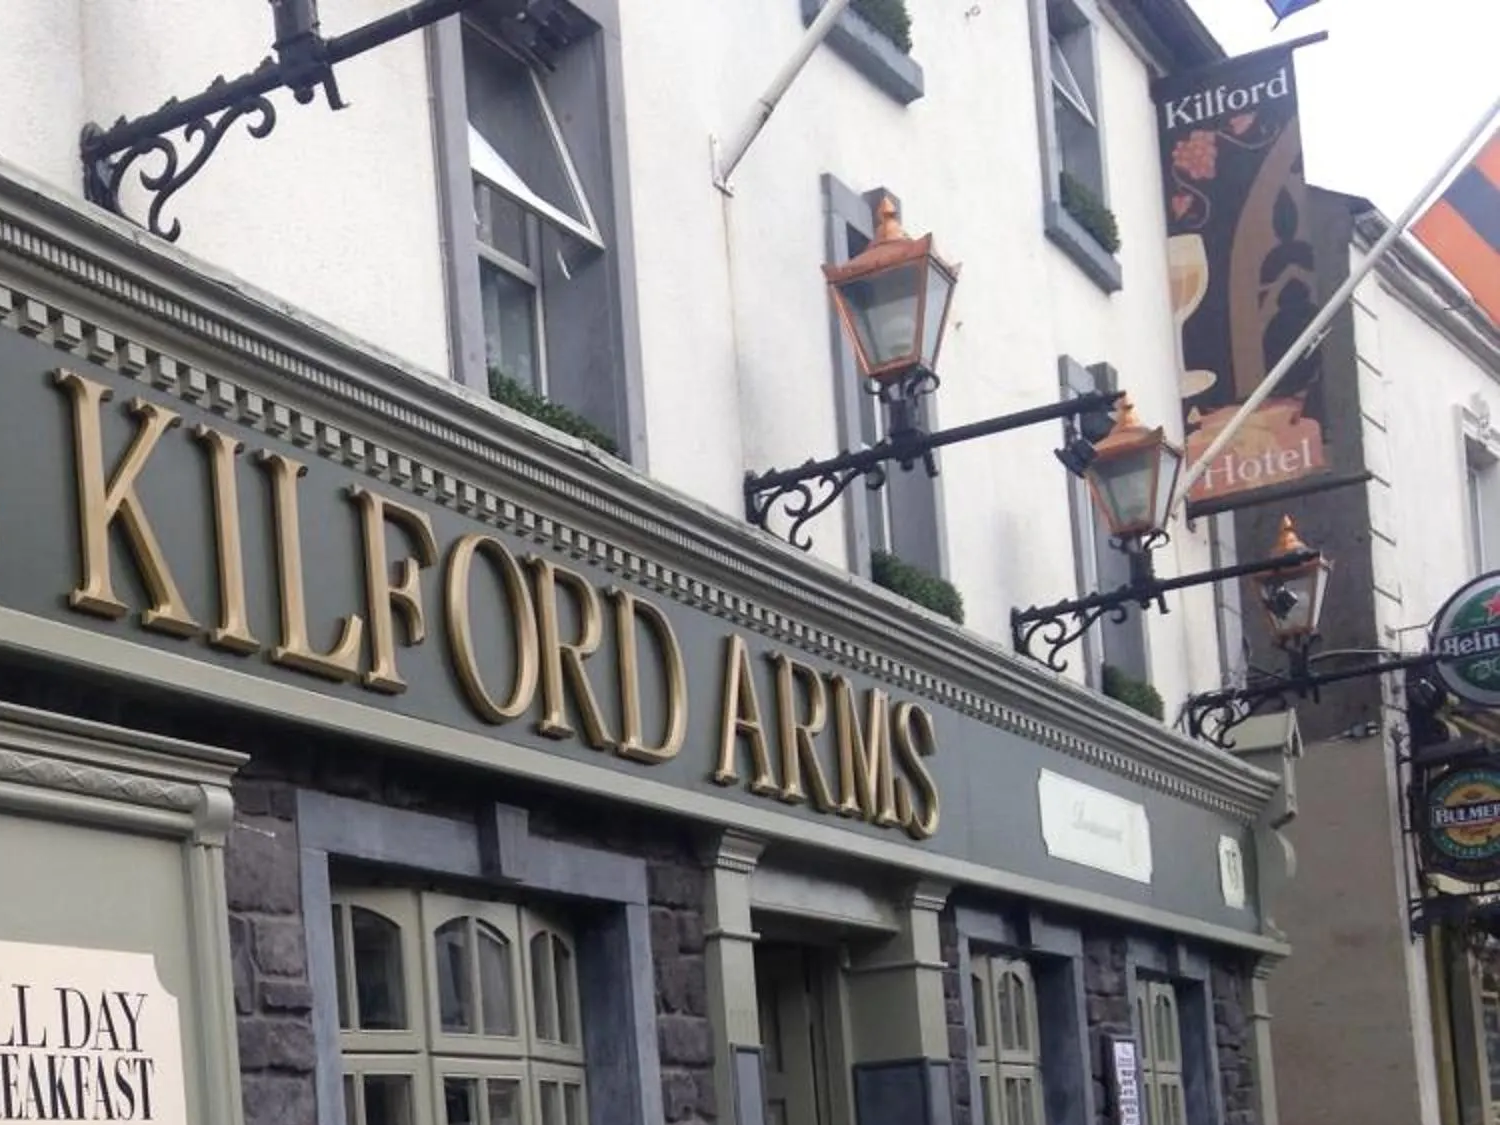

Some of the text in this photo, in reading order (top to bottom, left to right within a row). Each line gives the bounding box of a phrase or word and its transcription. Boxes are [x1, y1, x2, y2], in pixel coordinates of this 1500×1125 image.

[1164, 67, 1290, 129] Kilford
[1203, 438, 1313, 491] Hotel
[51, 366, 689, 766] KILFORD
[712, 632, 939, 841] ARMS
[53, 987, 148, 1052] DAY
